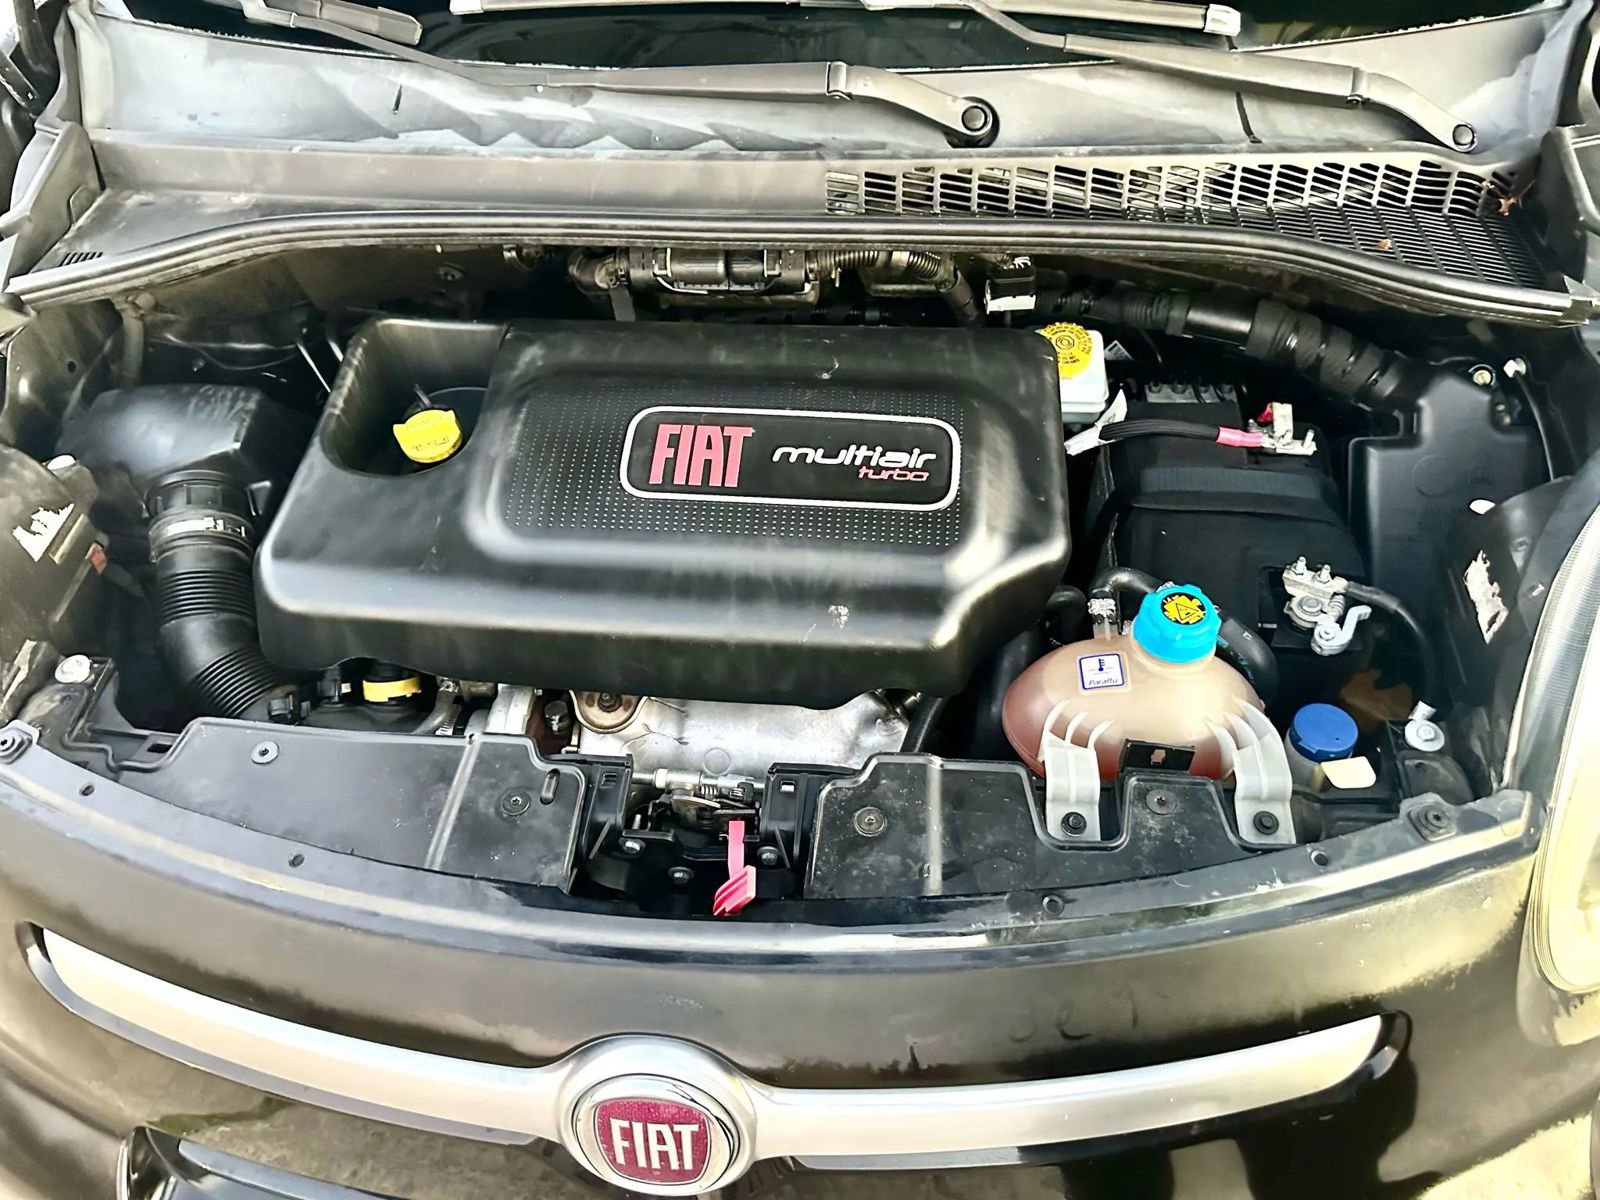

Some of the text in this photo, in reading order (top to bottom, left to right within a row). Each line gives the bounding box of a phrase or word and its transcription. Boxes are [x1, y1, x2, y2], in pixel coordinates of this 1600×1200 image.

[649, 424, 937, 487] FIAT multiair
[858, 466, 930, 482] turbo
[610, 1117, 699, 1171] FIAT
